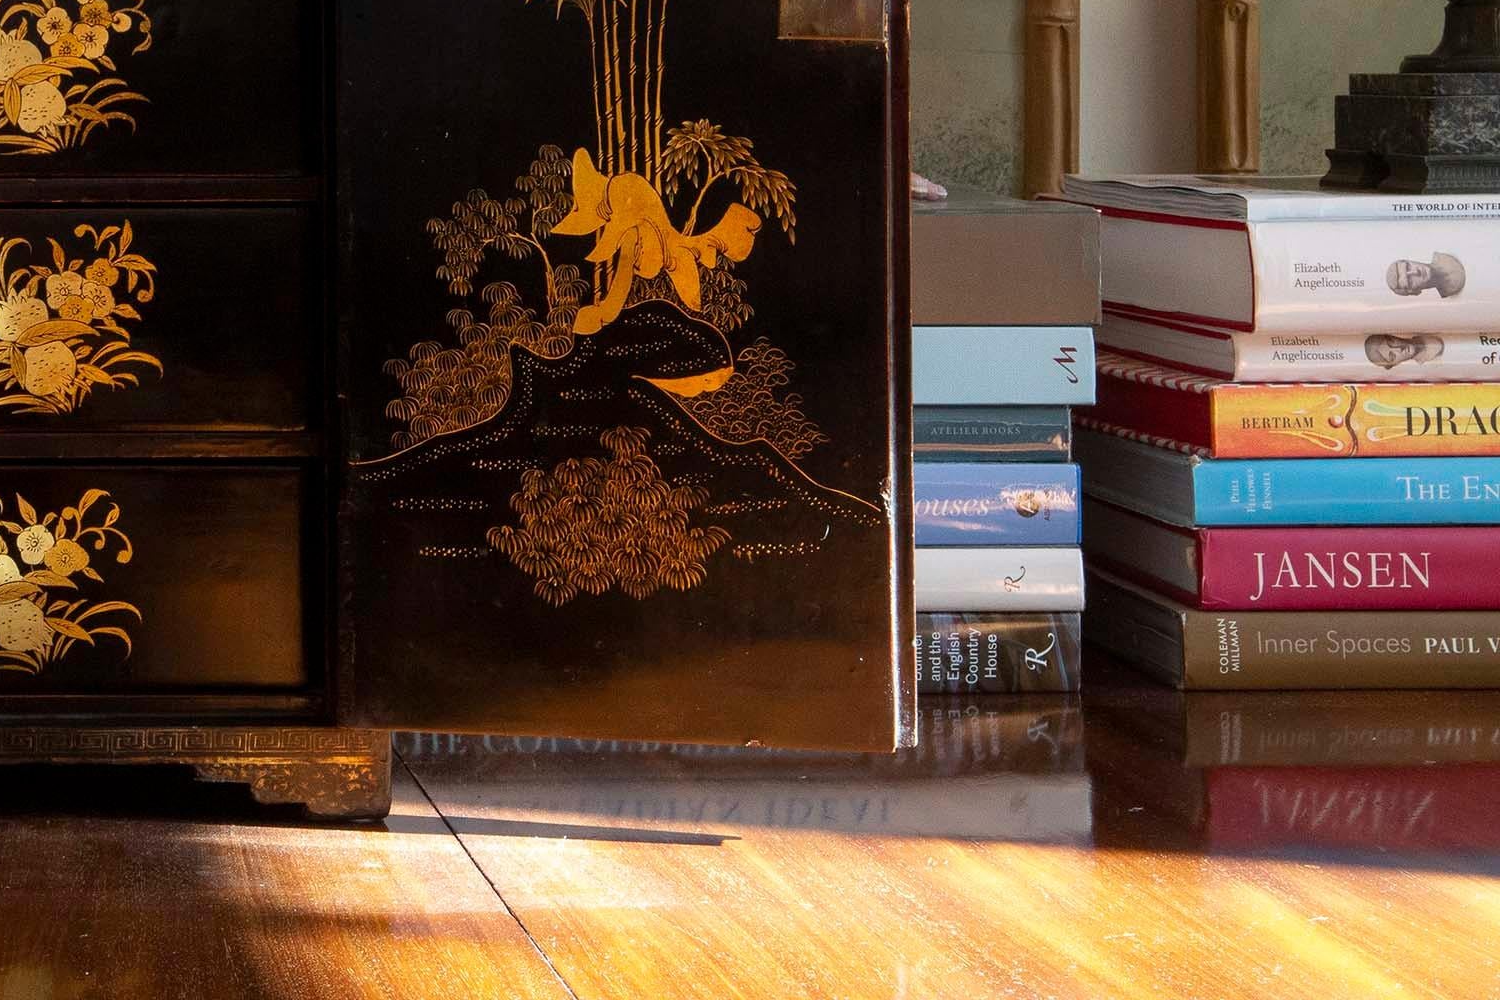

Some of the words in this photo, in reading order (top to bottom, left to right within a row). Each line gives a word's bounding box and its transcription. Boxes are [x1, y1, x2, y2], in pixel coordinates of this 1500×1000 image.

[1391, 203, 1414, 212] THE
[1416, 203, 1454, 212] WORLD
[1457, 203, 1469, 211] OF
[1294, 262, 1342, 274] Elizabeth
[1294, 277, 1365, 290] Angelicoussis
[1271, 335, 1320, 347] Elizabeth
[1272, 350, 1344, 363] Angelicoussis
[1481, 351, 1498, 365] of
[930, 426, 980, 436] ATELIER
[981, 426, 1021, 436] BOOKS
[1241, 416, 1315, 430] BERTRAM
[1249, 551, 1431, 601] JANSEN
[930, 631, 942, 656] the
[946, 631, 963, 681] English
[965, 627, 982, 685] Country
[1024, 632, 1056, 671] R
[1217, 618, 1229, 675] COLEMAN
[1230, 619, 1241, 673] MILLMAN
[1257, 631, 1318, 654] Inner
[1326, 630, 1411, 660] Spaces
[1423, 638, 1480, 655] PAUL
[984, 634, 998, 679] House
[931, 657, 942, 682] and
